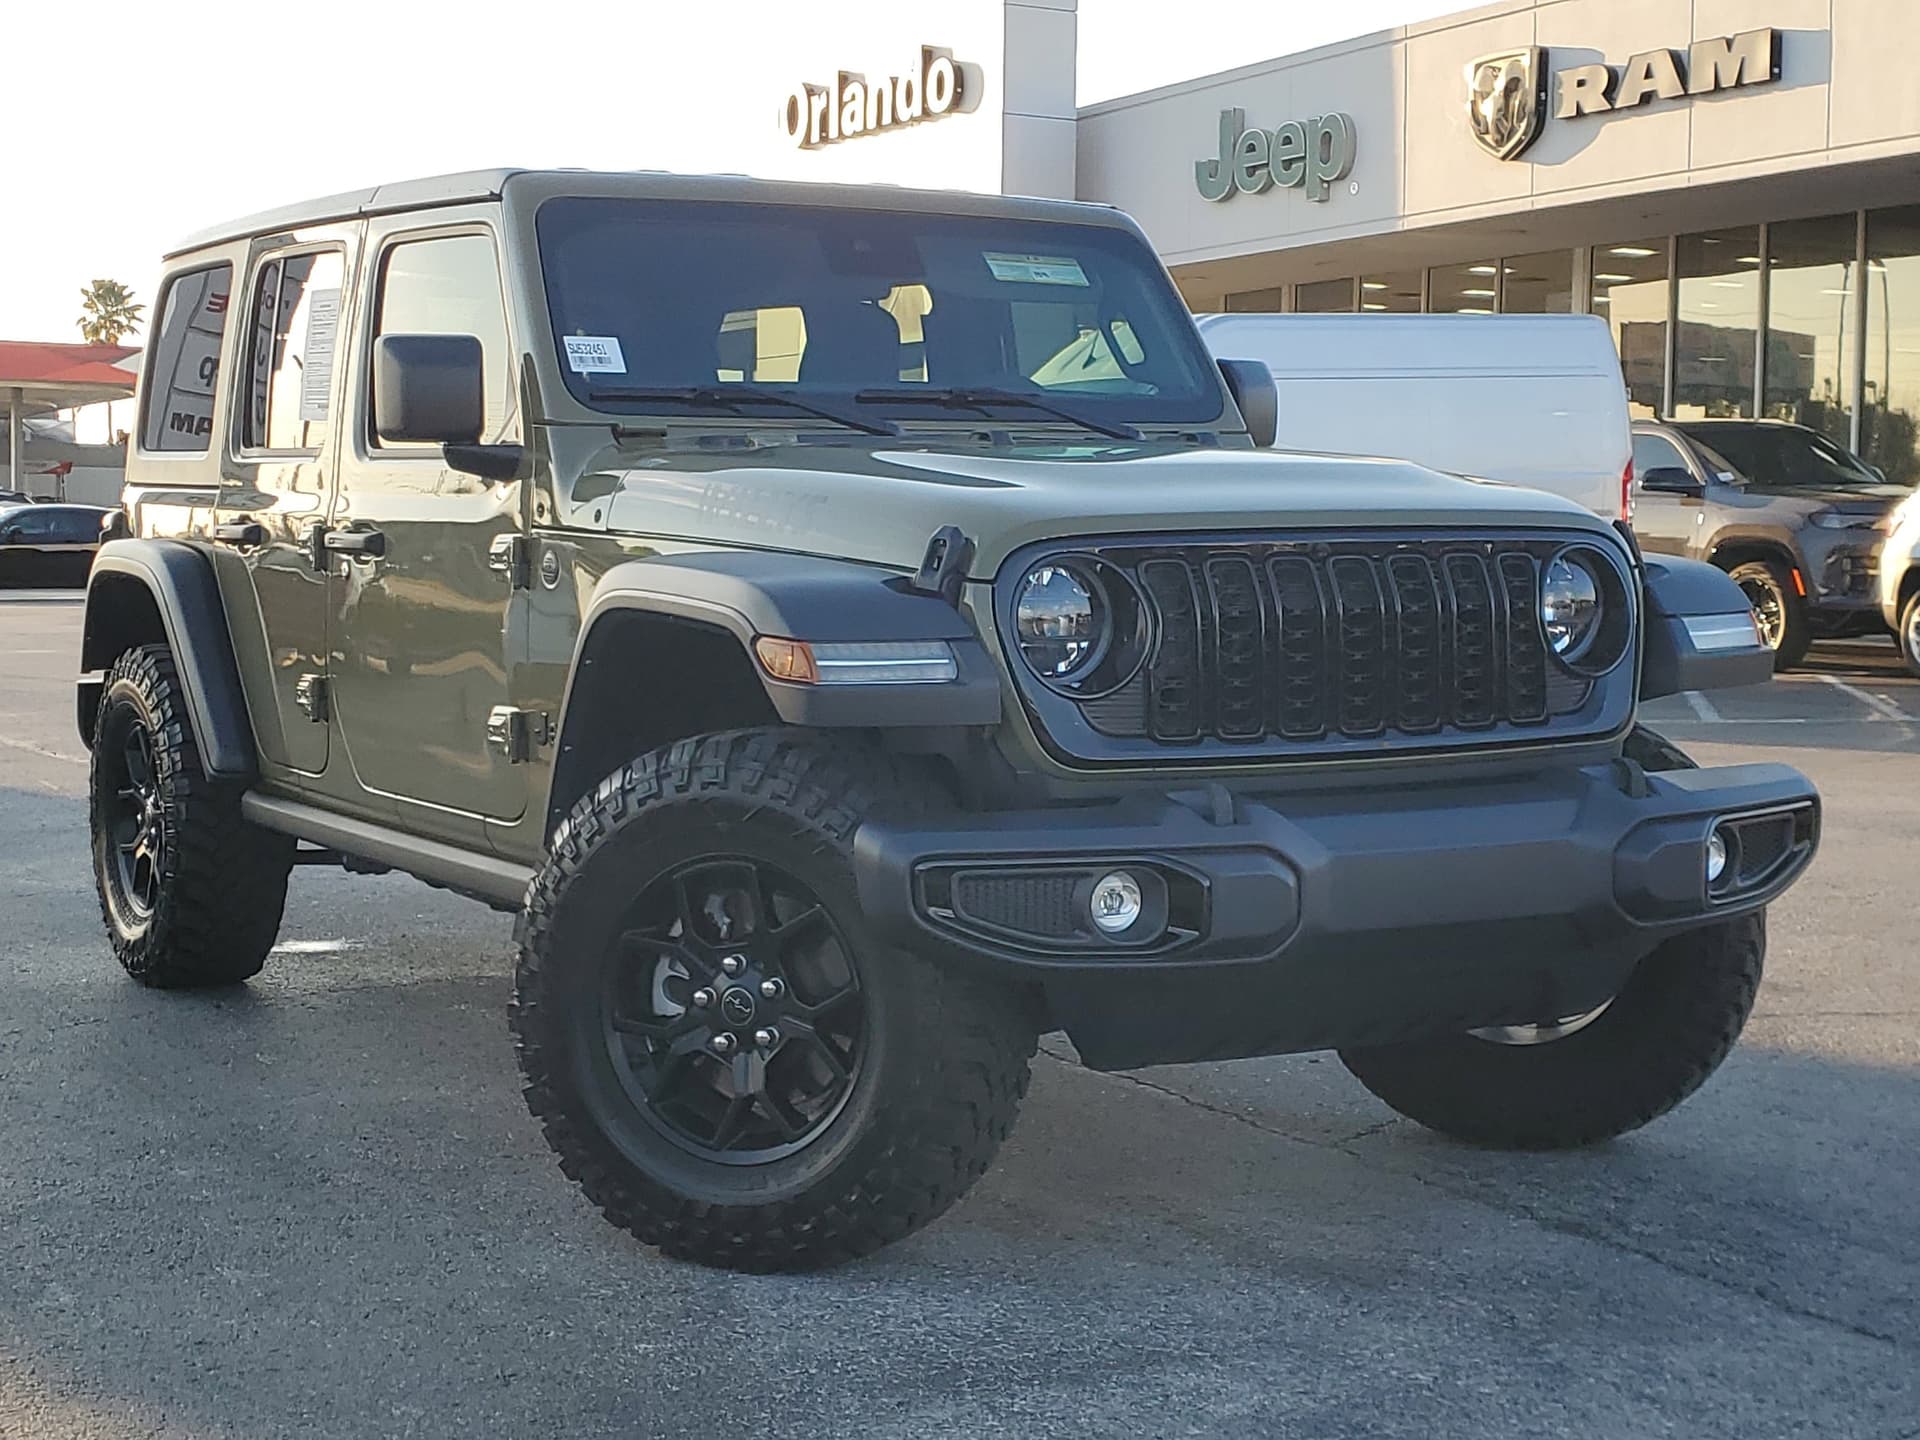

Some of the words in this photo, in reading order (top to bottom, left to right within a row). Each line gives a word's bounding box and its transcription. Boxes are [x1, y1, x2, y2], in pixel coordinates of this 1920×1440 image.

[778, 44, 958, 149] Orlando
[1552, 28, 1781, 119] RAM
[1195, 106, 1357, 202] Jeep
